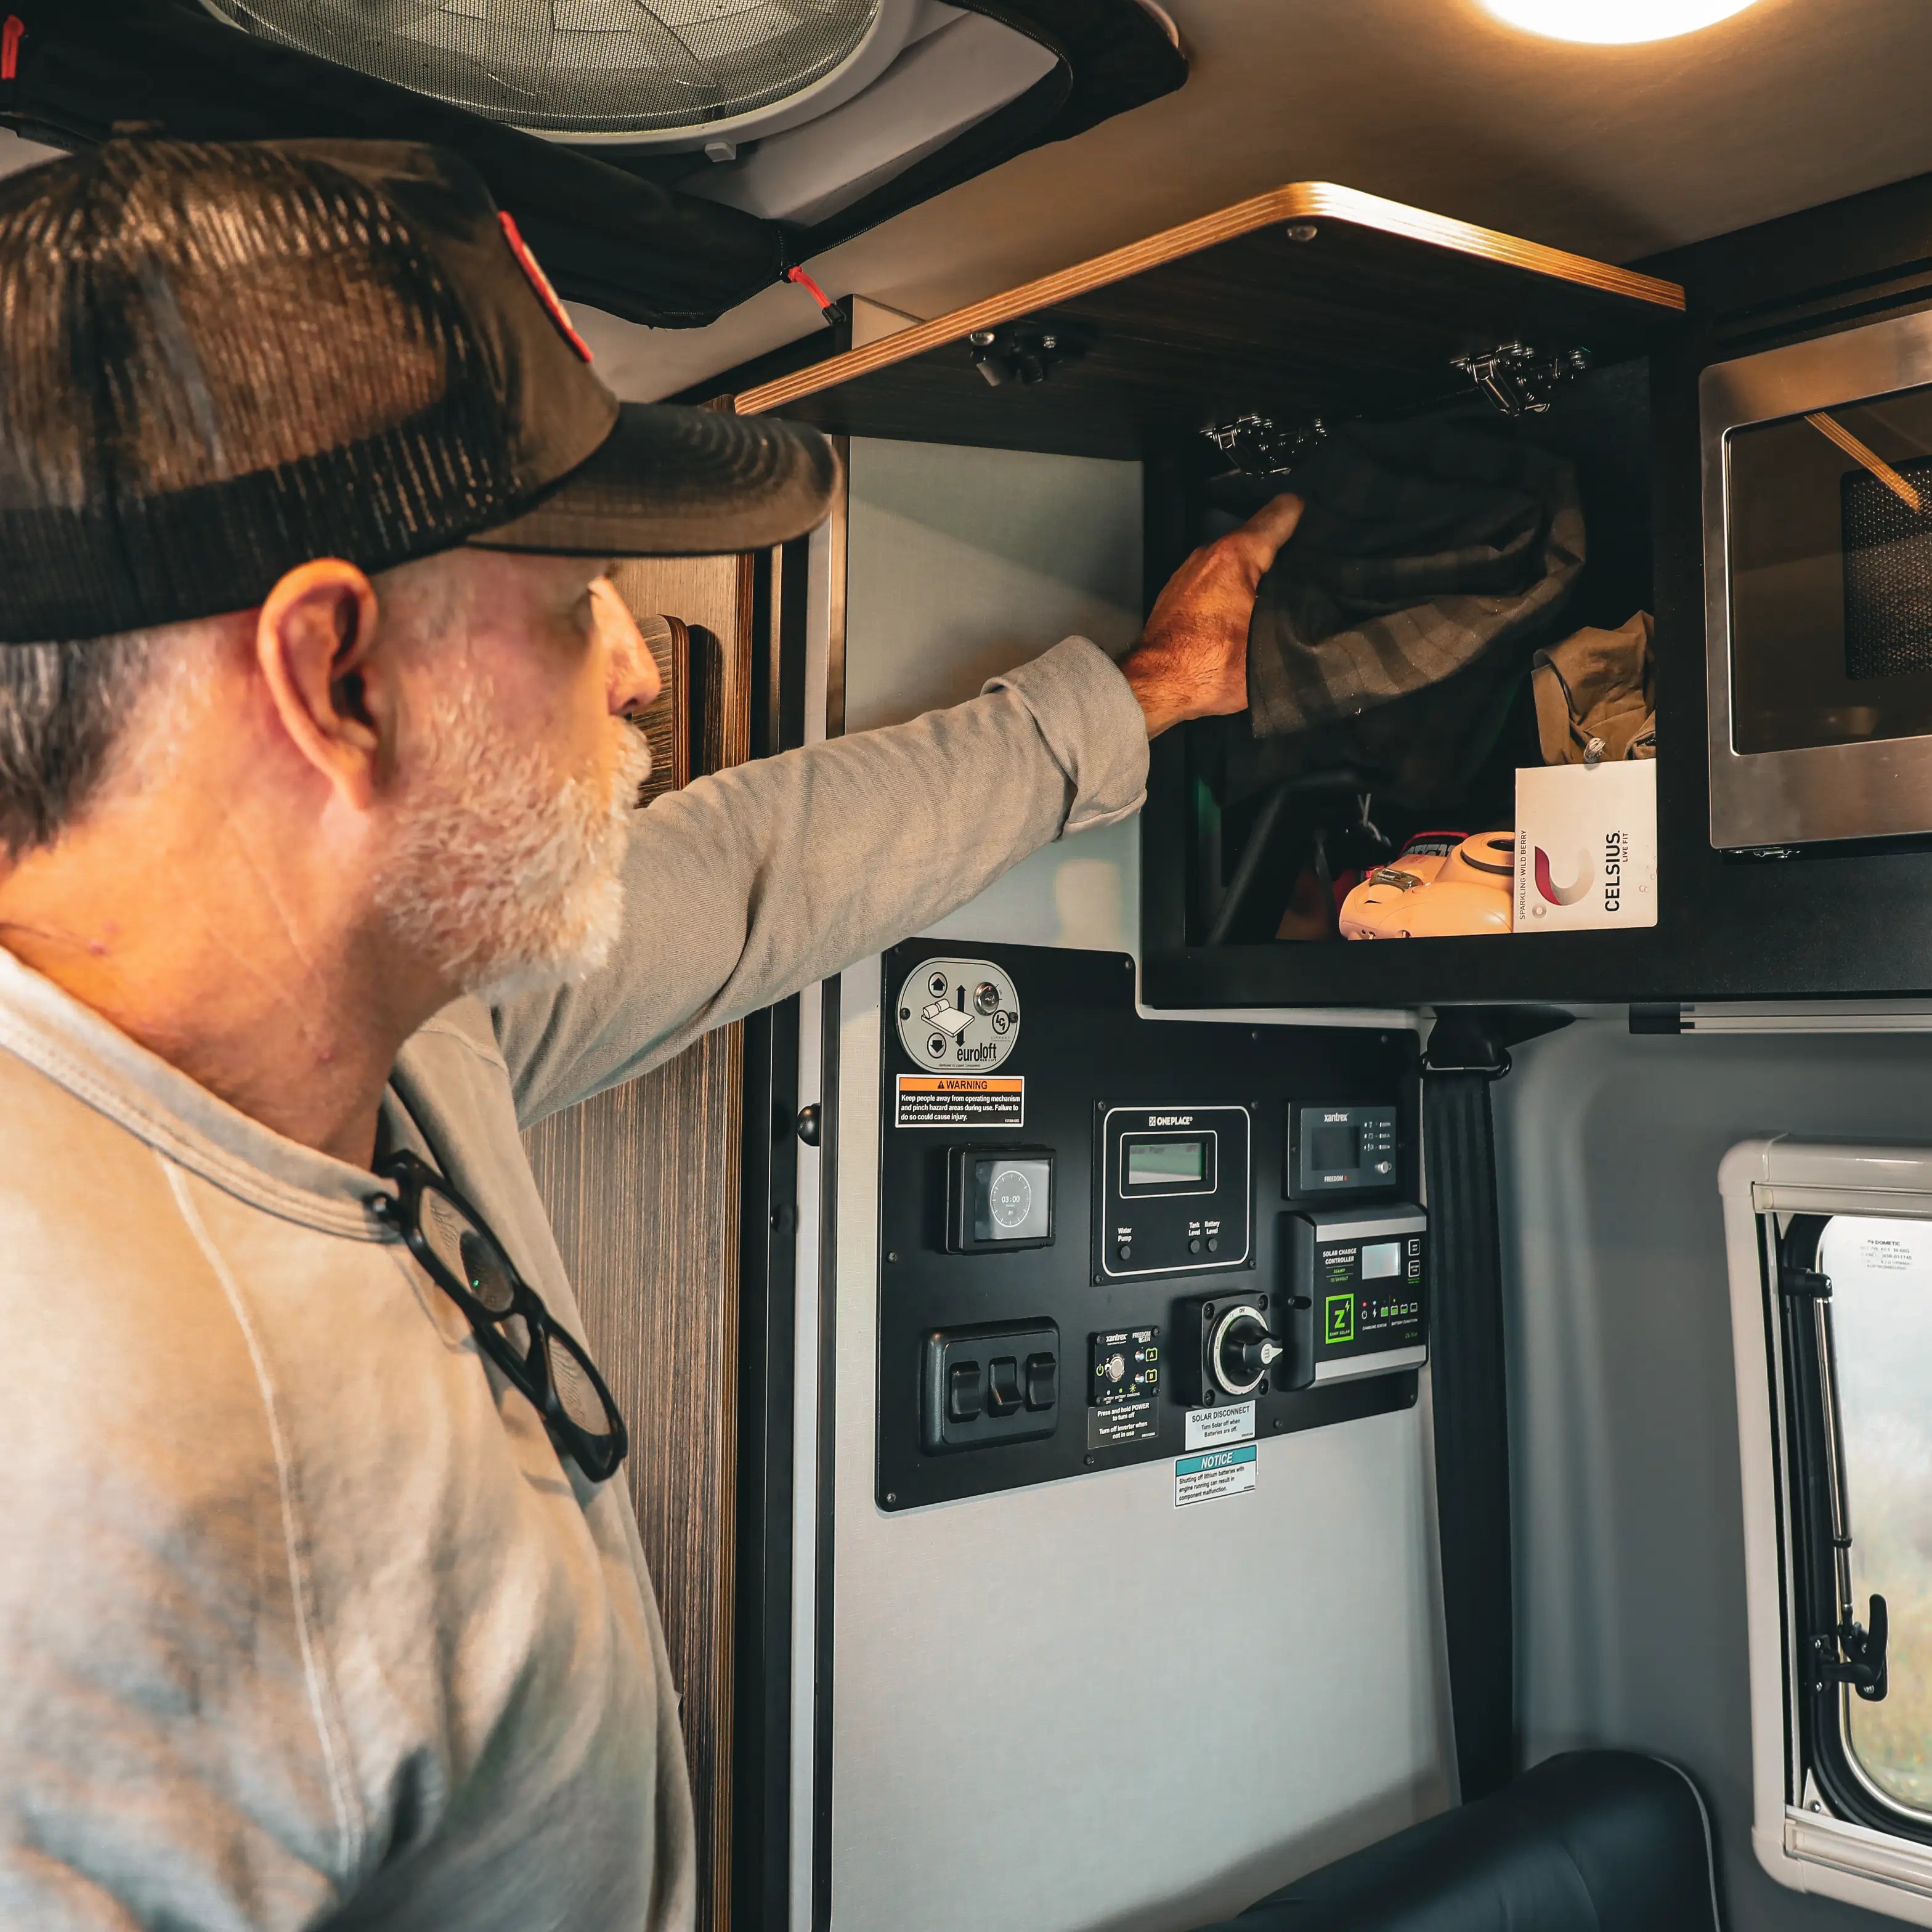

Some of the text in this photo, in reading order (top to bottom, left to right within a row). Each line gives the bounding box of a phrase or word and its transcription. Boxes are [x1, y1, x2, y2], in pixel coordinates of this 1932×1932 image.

[957, 1042, 997, 1061] euroloft
[946, 1081, 988, 1090] WARNING
[901, 1095, 916, 1103] Keep
[917, 1095, 936, 1103] people
[965, 1095, 991, 1103] operating
[912, 1104, 928, 1112] pinch
[964, 1104, 982, 1113] during
[951, 1113, 968, 1121] injury.
[1324, 1113, 1349, 1122] xantrex
[1001, 1195, 1020, 1203] 03:00
[1204, 1220, 1220, 1228] Battery
[1323, 1248, 1357, 1257] SOLAR CHARGE
[1325, 1256, 1355, 1265] CONTROLLER
[1334, 1309, 1345, 1329] Z
[1106, 1333, 1128, 1342] xantrex
[1132, 1331, 1151, 1339] FREEDOM
[1132, 1402, 1150, 1411] POWER
[1192, 1405, 1250, 1423] SOLAR DISCONNECT
[1118, 1423, 1135, 1431] inverter
[1201, 1451, 1233, 1469] NOTICE
[1179, 1476, 1196, 1484] Shutting
[1218, 1468, 1235, 1476] batteries
[1179, 1485, 1193, 1493] engine
[1194, 1482, 1210, 1490] running
[1179, 1486, 1227, 1501] component malfunction.
